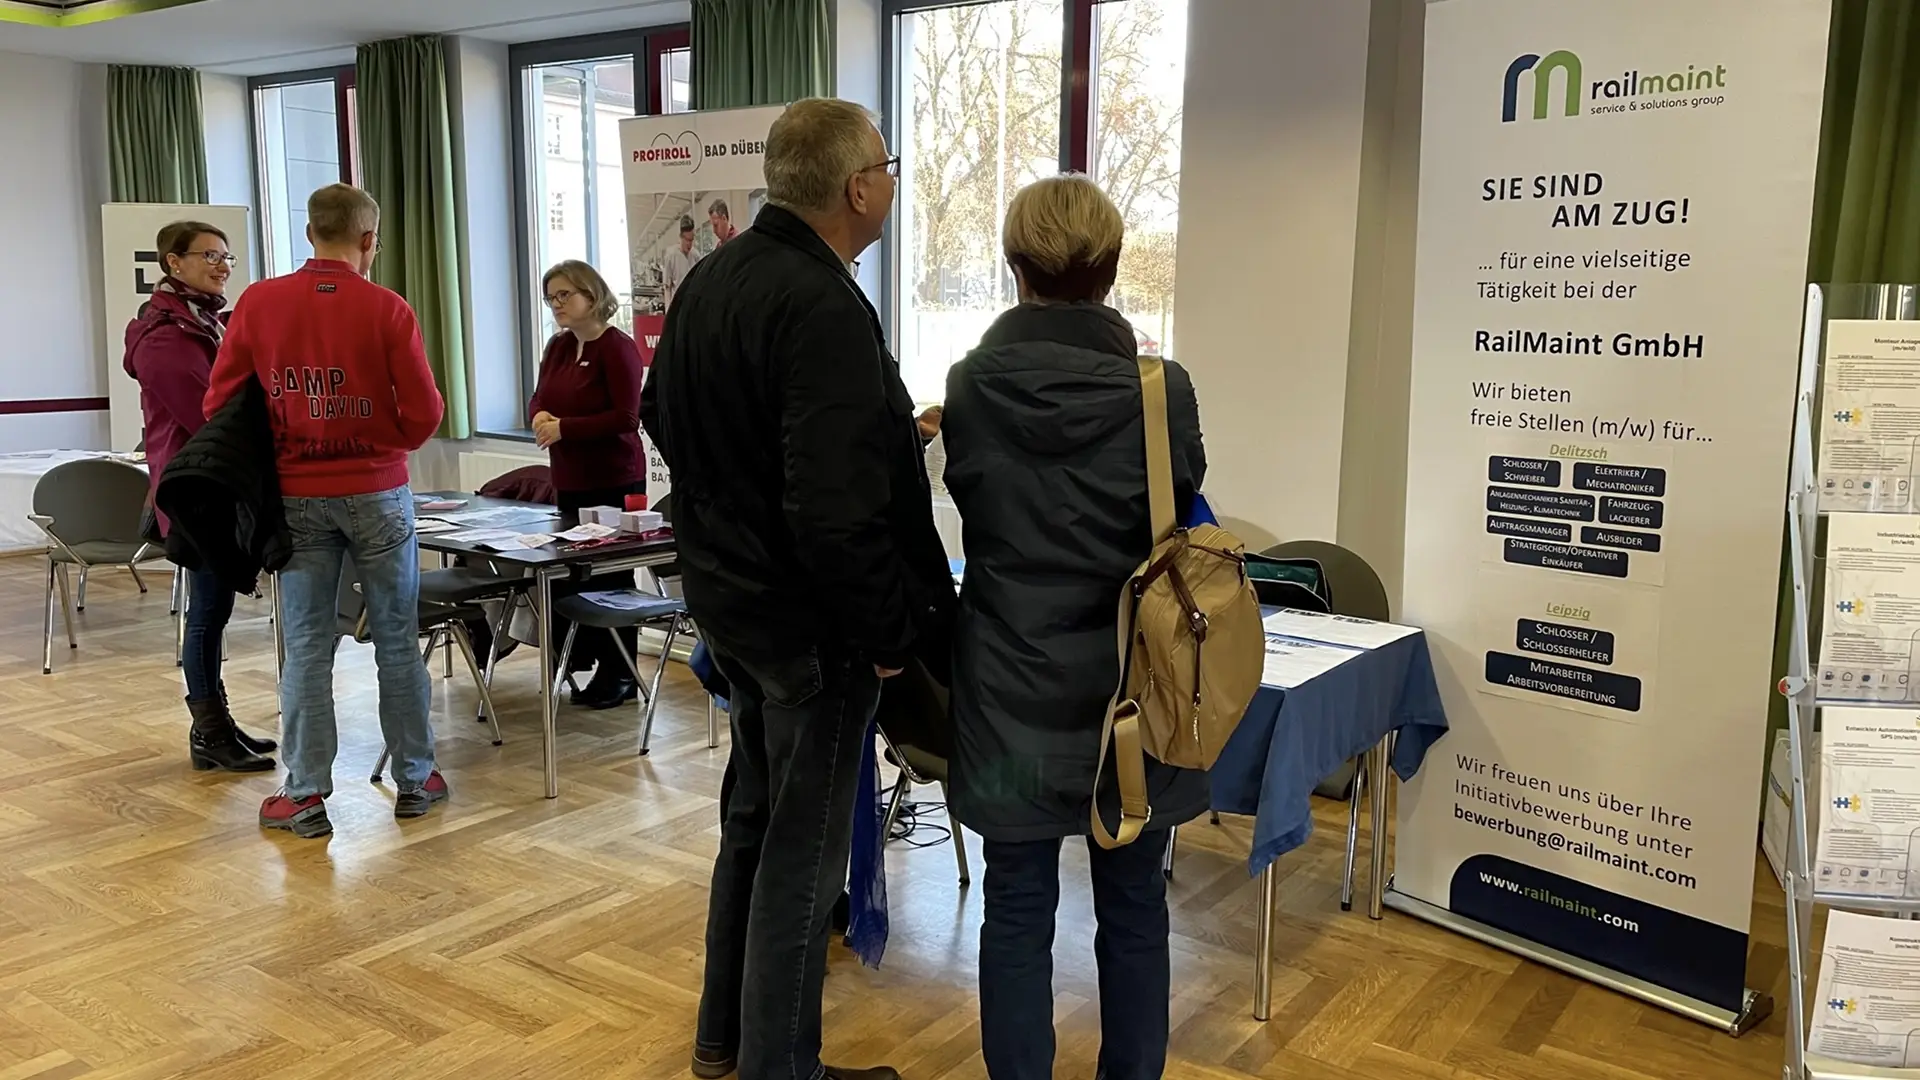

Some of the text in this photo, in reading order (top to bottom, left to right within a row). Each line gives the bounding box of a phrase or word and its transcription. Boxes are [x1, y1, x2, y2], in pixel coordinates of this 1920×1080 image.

[1591, 65, 1727, 100] railmaint
[1590, 95, 1725, 115] service & solutions group
[633, 146, 692, 162] PROFIROLL
[704, 144, 727, 157] BAD
[1482, 172, 1604, 202] SIE SIND
[1551, 198, 1689, 228] AM ZUG!
[1500, 251, 1528, 270] für
[1533, 251, 1575, 269] eine
[1582, 249, 1691, 272] vielseitige
[1477, 280, 1637, 302] Tätigkeit bei der
[1475, 330, 1704, 358] RailMaint GmbH
[270, 366, 345, 399] CAMP
[1472, 381, 1572, 403] Wir bieten
[309, 395, 373, 419] DAVID
[1470, 408, 1513, 428] freie
[1518, 412, 1584, 433] Stellen
[1592, 416, 1655, 442] (m/w)
[1549, 443, 1608, 461] Delitzsch
[1546, 602, 1591, 621] Leipzig
[1456, 753, 1692, 831] Wir freuen uns über Ihre
[1455, 779, 1693, 859] Initiativbewerbung unter
[1454, 803, 1697, 890] bewerbung@railmaint.com
[1479, 870, 1640, 933] www.railmaint.com
